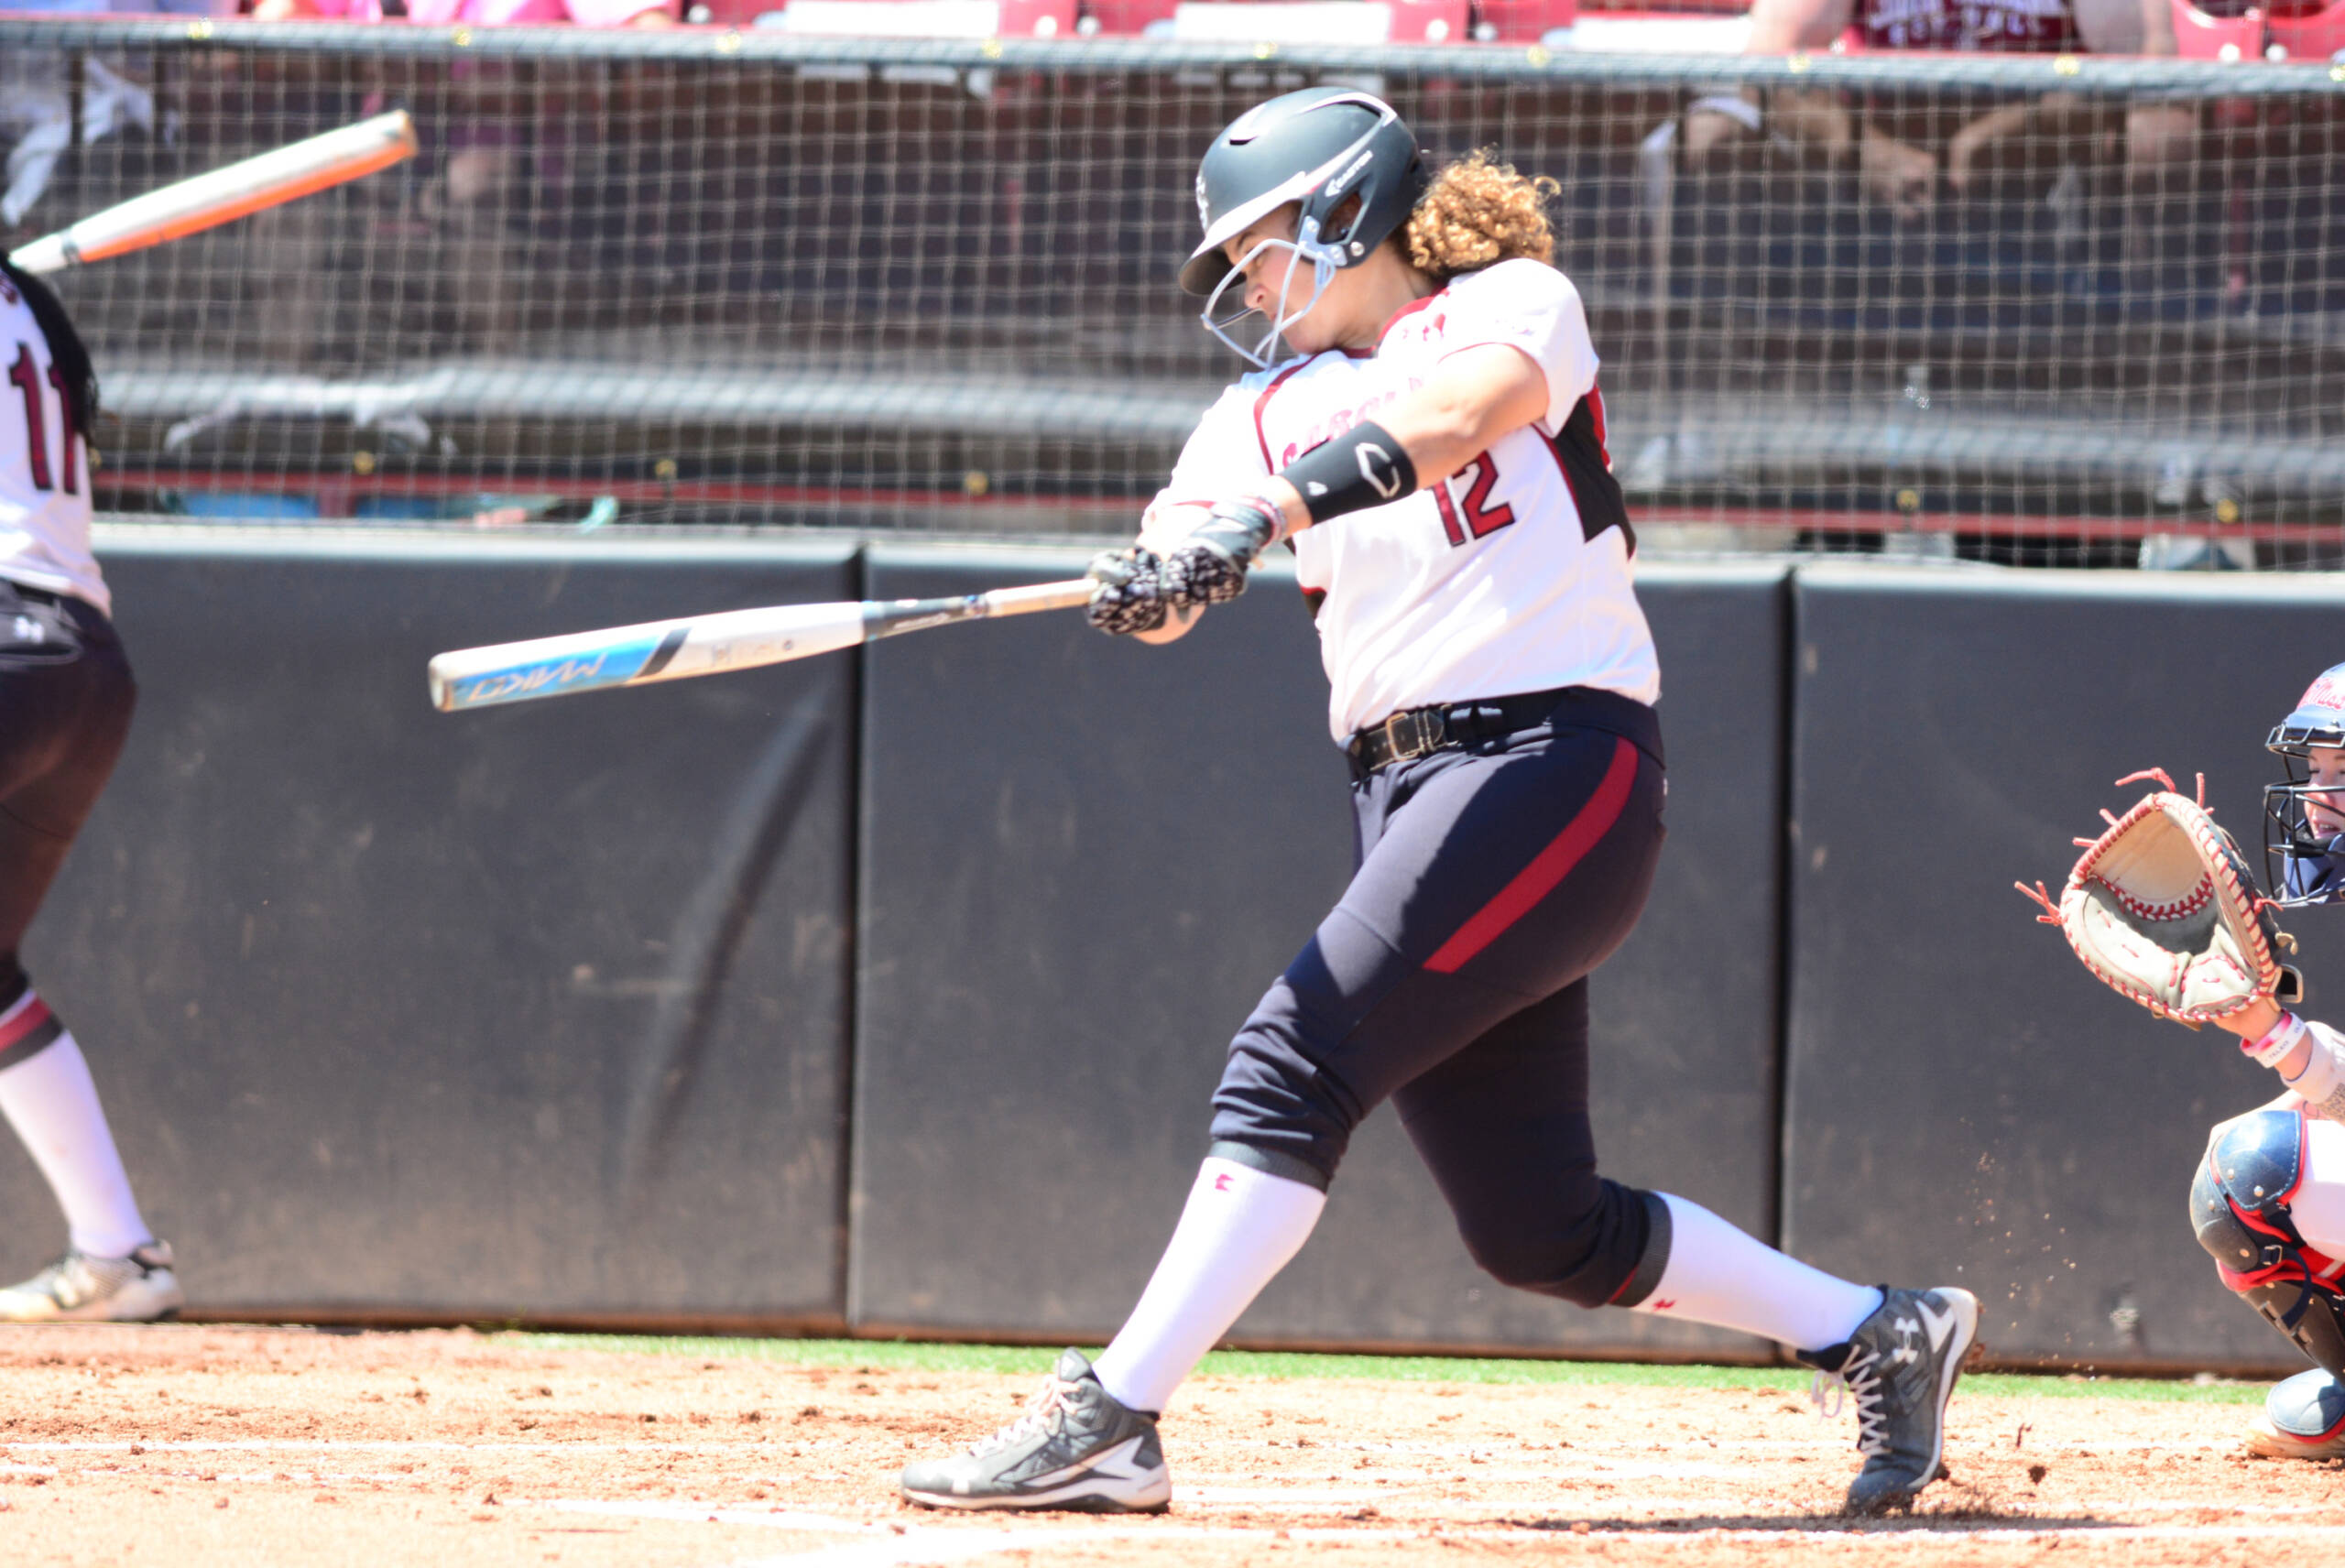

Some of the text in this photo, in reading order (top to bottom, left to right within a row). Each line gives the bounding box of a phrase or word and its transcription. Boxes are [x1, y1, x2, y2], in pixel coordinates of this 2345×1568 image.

[8, 341, 78, 495] 11
[1423, 450, 1516, 548] 12
[467, 651, 608, 702] MAKO
